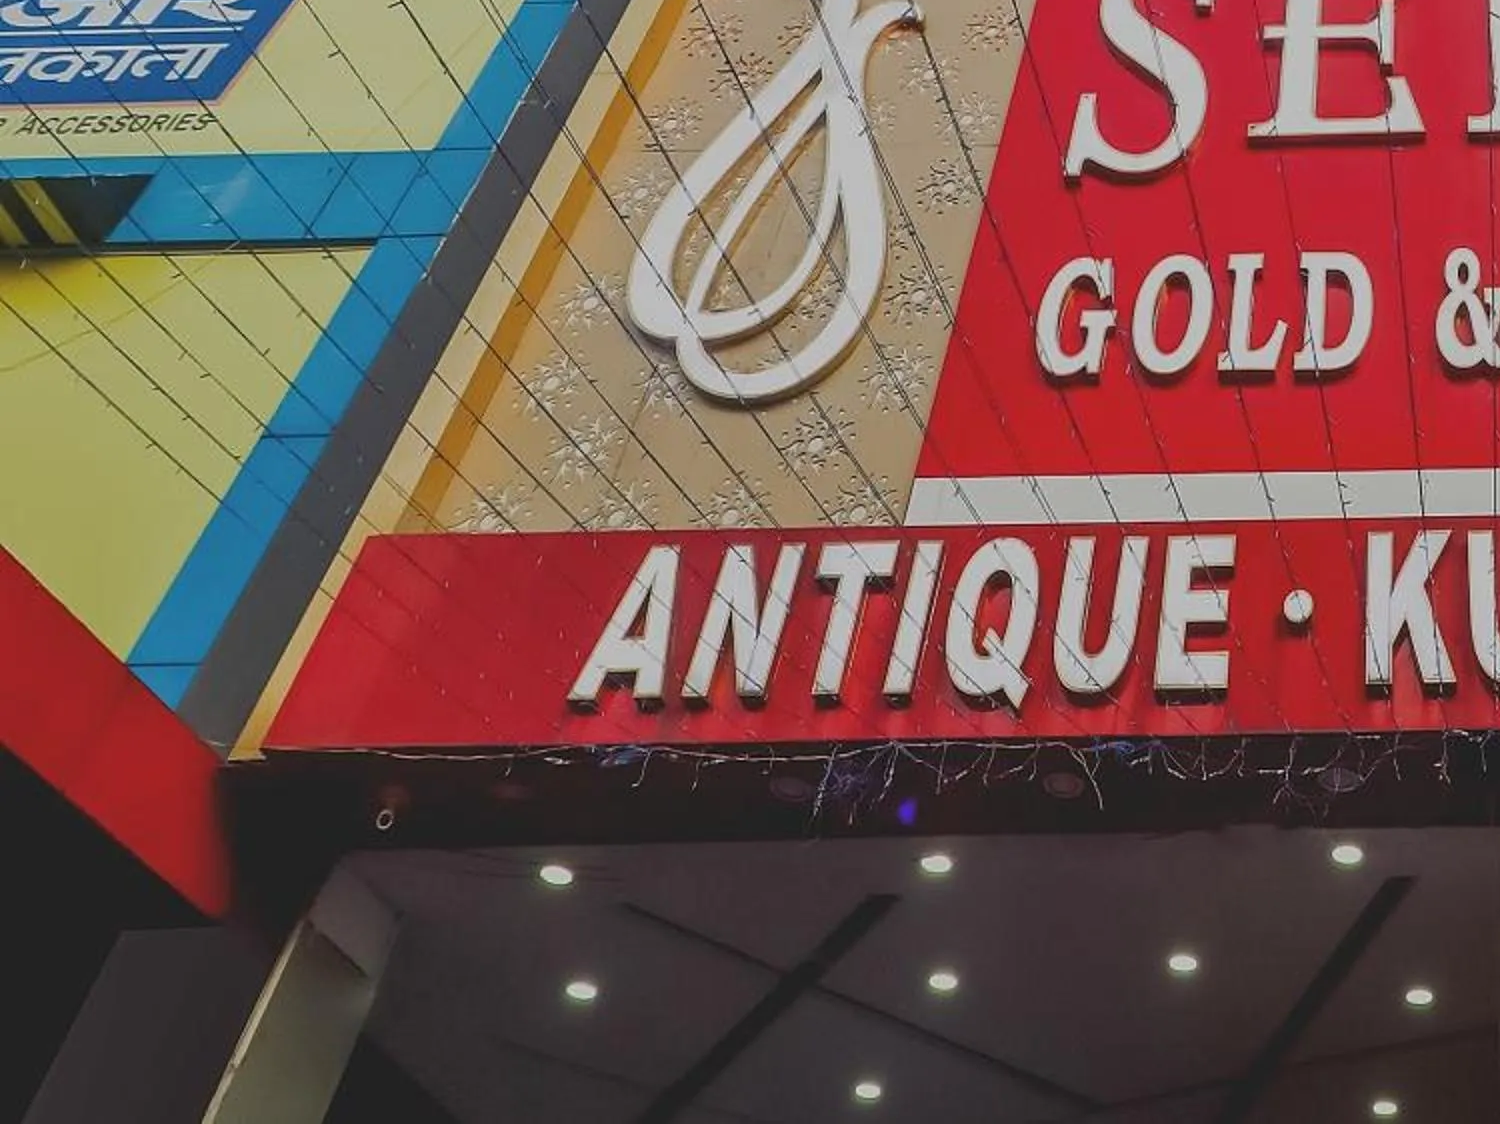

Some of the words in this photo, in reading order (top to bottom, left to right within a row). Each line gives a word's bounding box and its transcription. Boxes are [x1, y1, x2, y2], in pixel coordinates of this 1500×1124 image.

[14, 112, 218, 136] ACCESSORIES
[1035, 250, 1374, 380] GOLD
[565, 534, 1237, 712] ANTIQUE
